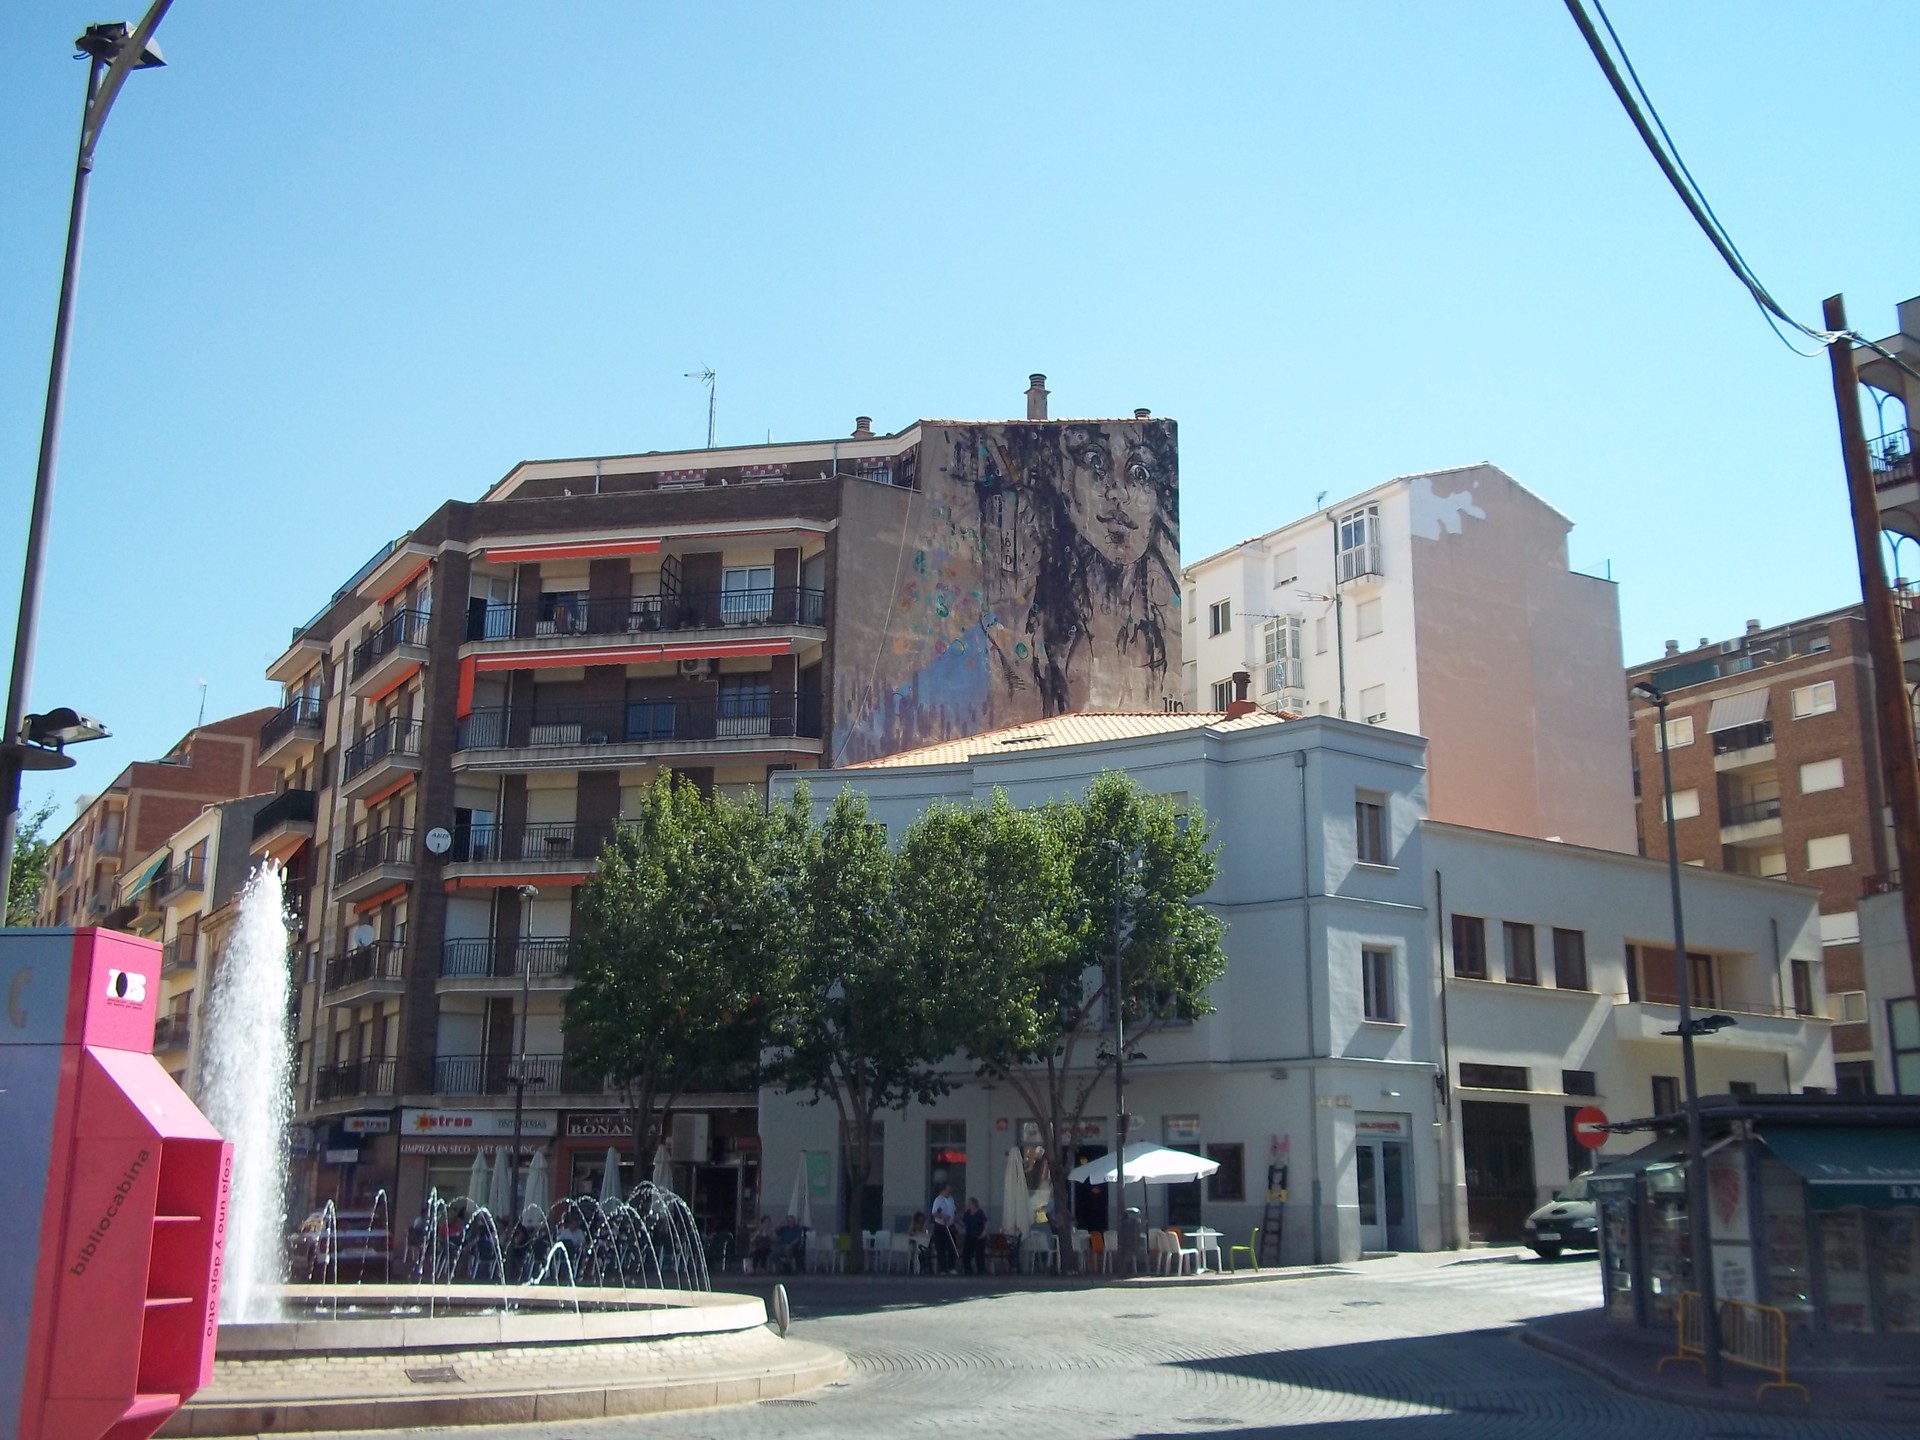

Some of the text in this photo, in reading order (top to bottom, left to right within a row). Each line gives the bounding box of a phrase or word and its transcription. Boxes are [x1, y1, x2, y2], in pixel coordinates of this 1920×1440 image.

[571, 1123, 657, 1135] BONANA
[222, 1157, 231, 1194] coja
[69, 1149, 150, 1277] bibliocabina
[217, 1200, 226, 1234] uno
[214, 1240, 222, 1250] y
[206, 1300, 216, 1337] otro
